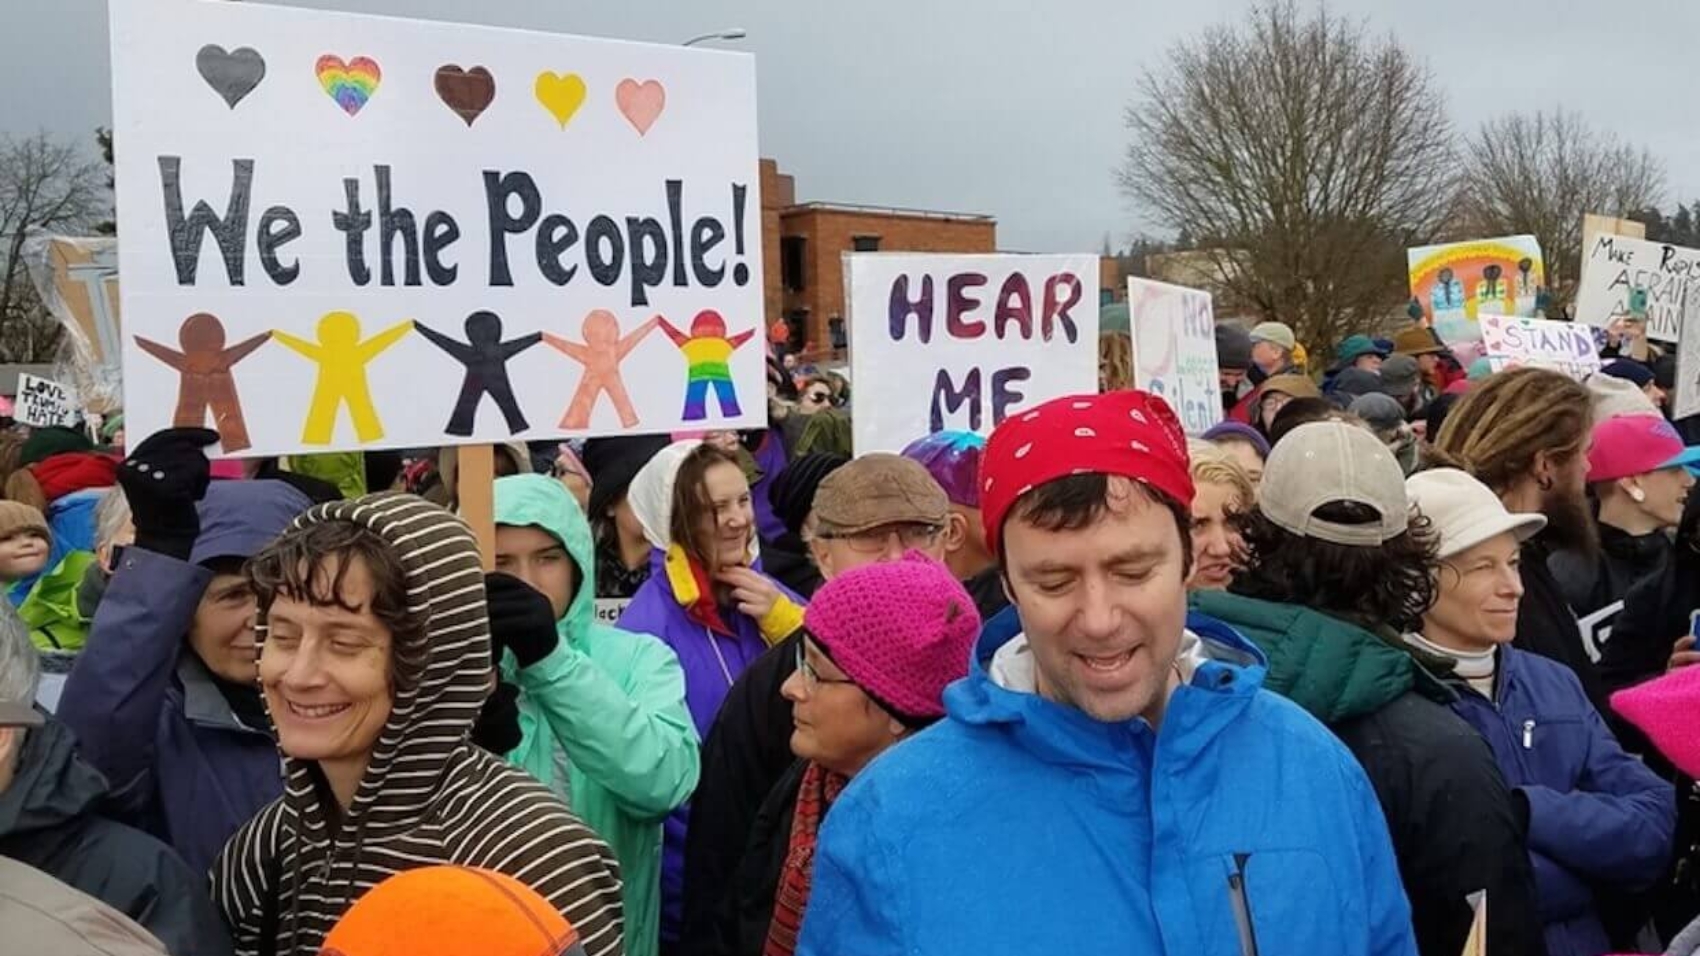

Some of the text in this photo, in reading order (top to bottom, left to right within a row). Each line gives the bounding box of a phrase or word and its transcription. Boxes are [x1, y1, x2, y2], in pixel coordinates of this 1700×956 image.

[157, 156, 750, 307] We the People!
[889, 271, 1082, 345] HEAR
[1608, 269, 1683, 304] AFRAI
[1502, 325, 1591, 357] STAND
[1606, 300, 1677, 335] AAIN
[930, 366, 1031, 434] ME
